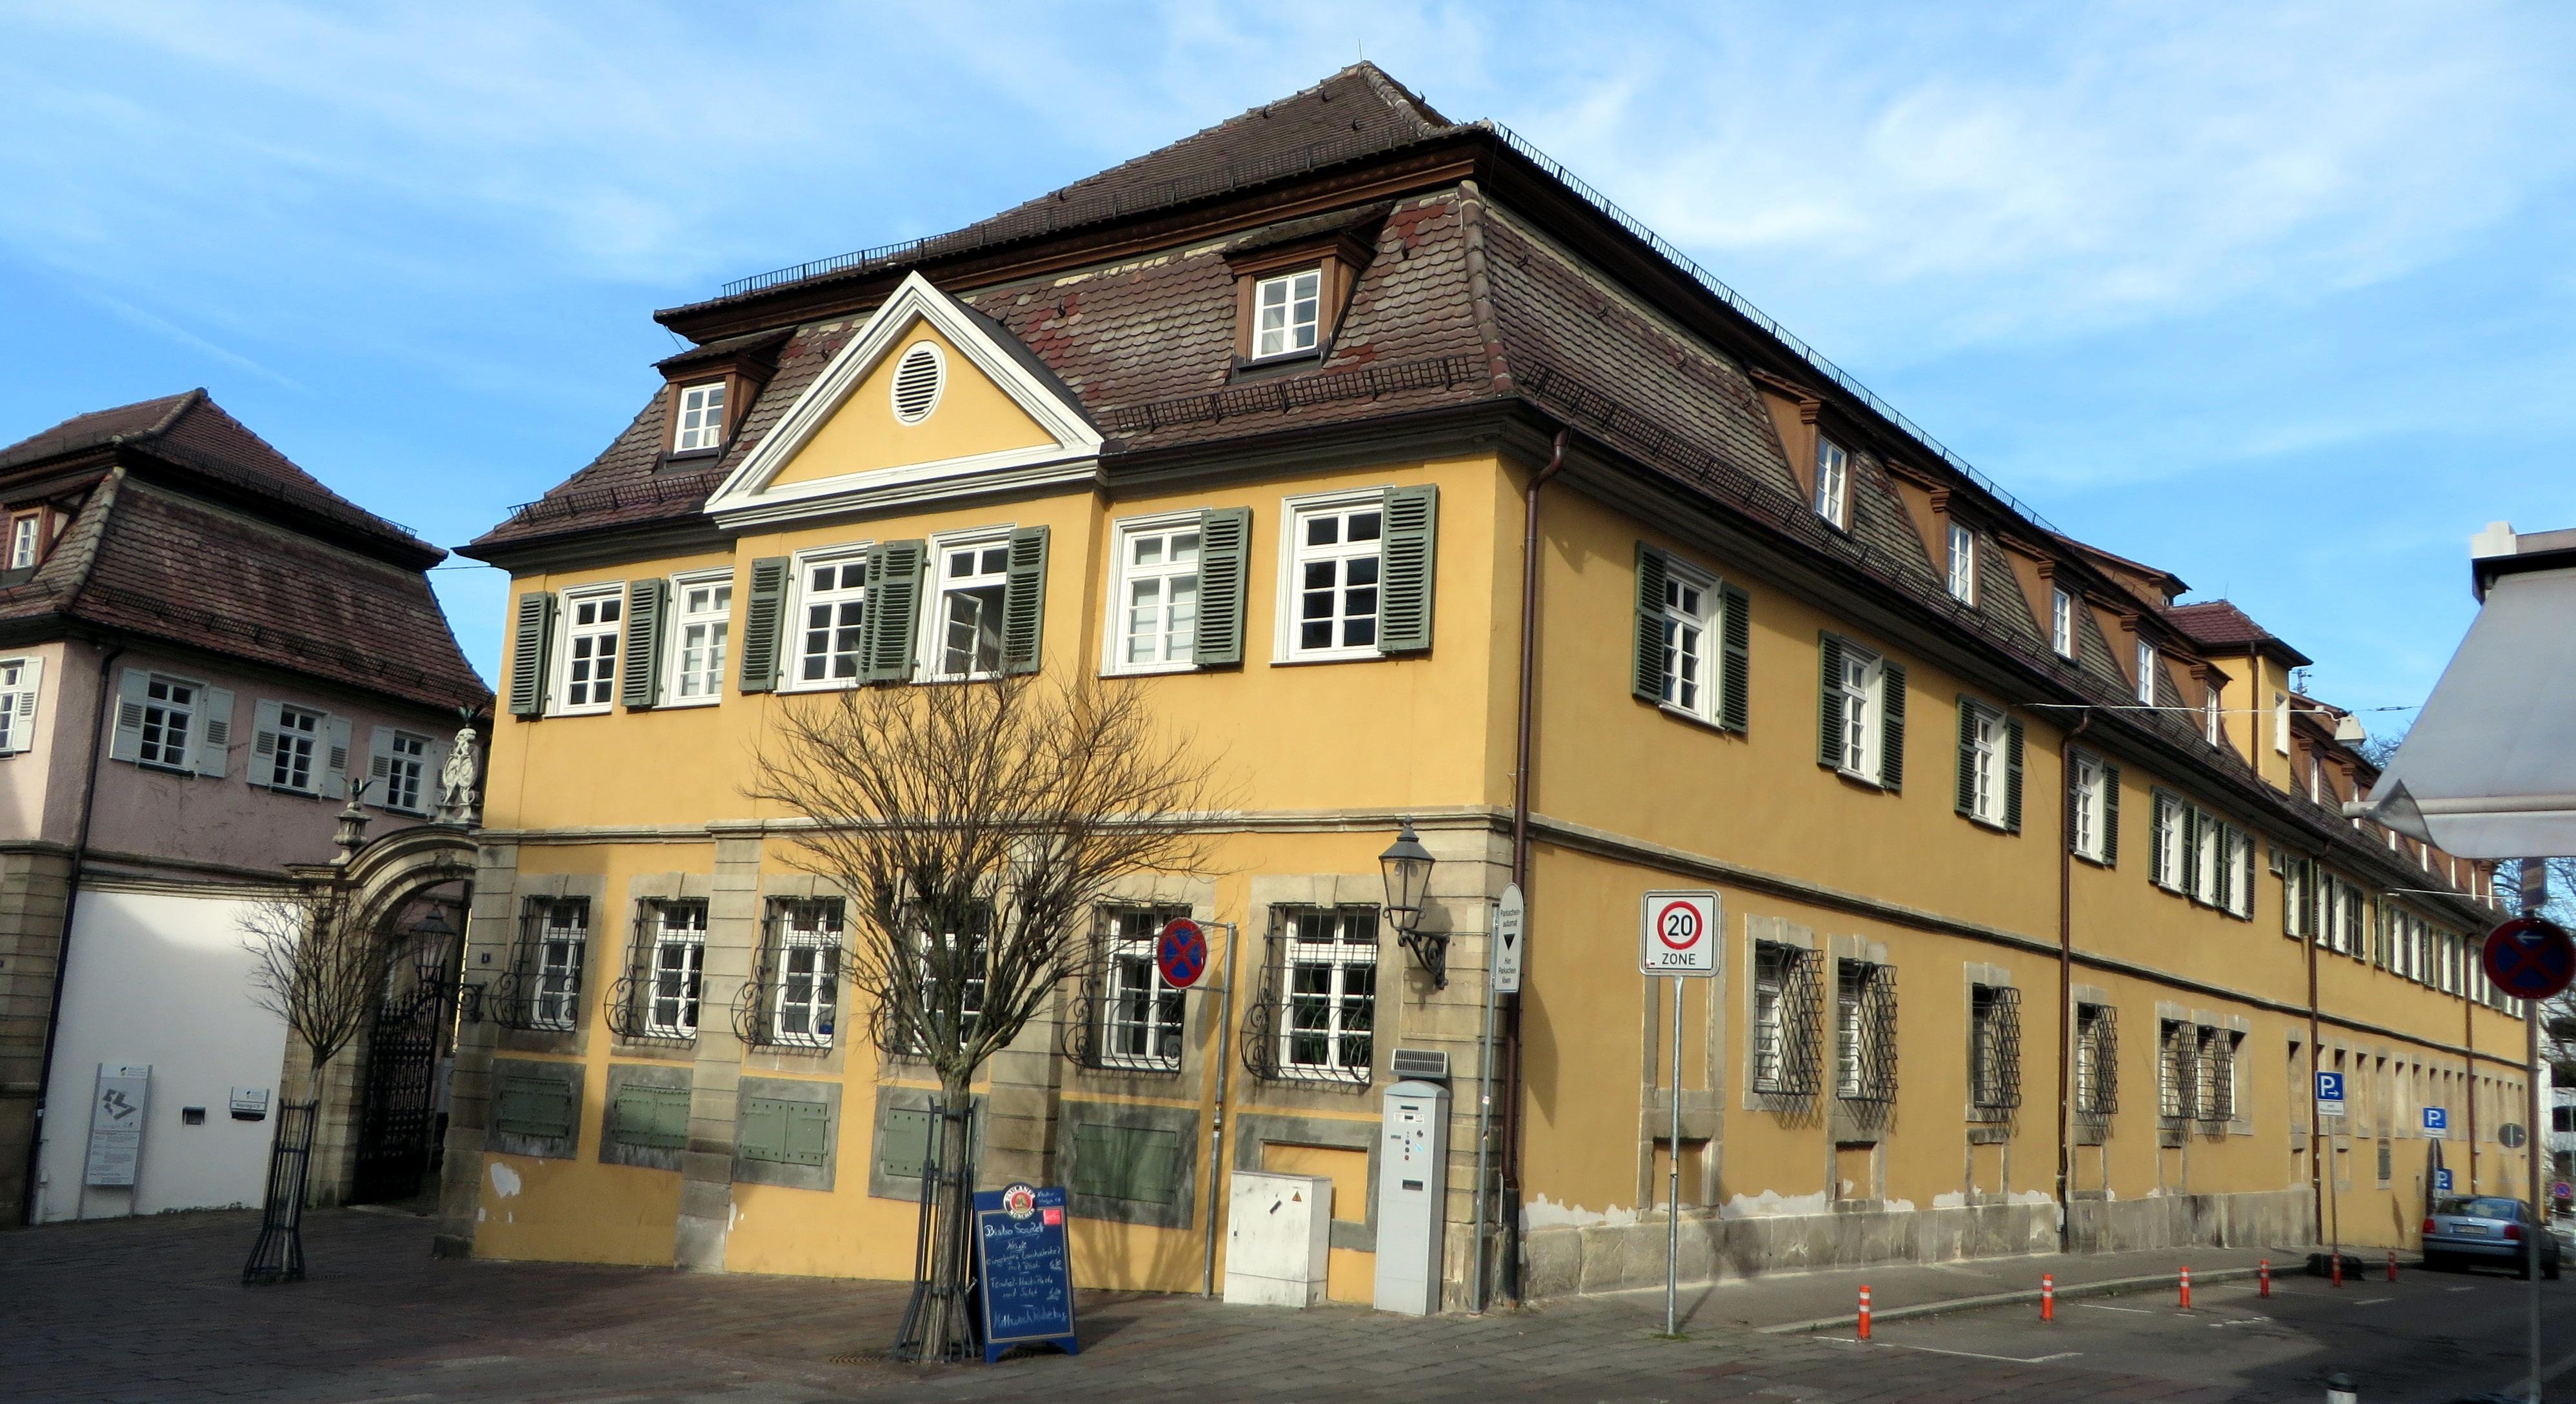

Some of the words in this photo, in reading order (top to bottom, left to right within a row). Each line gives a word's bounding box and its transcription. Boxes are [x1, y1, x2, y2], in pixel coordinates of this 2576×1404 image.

[1668, 914, 1693, 936] 20
[1662, 953, 1696, 965] ZONE
[2321, 1075, 2335, 1096] P
[2428, 1110, 2441, 1126] P
